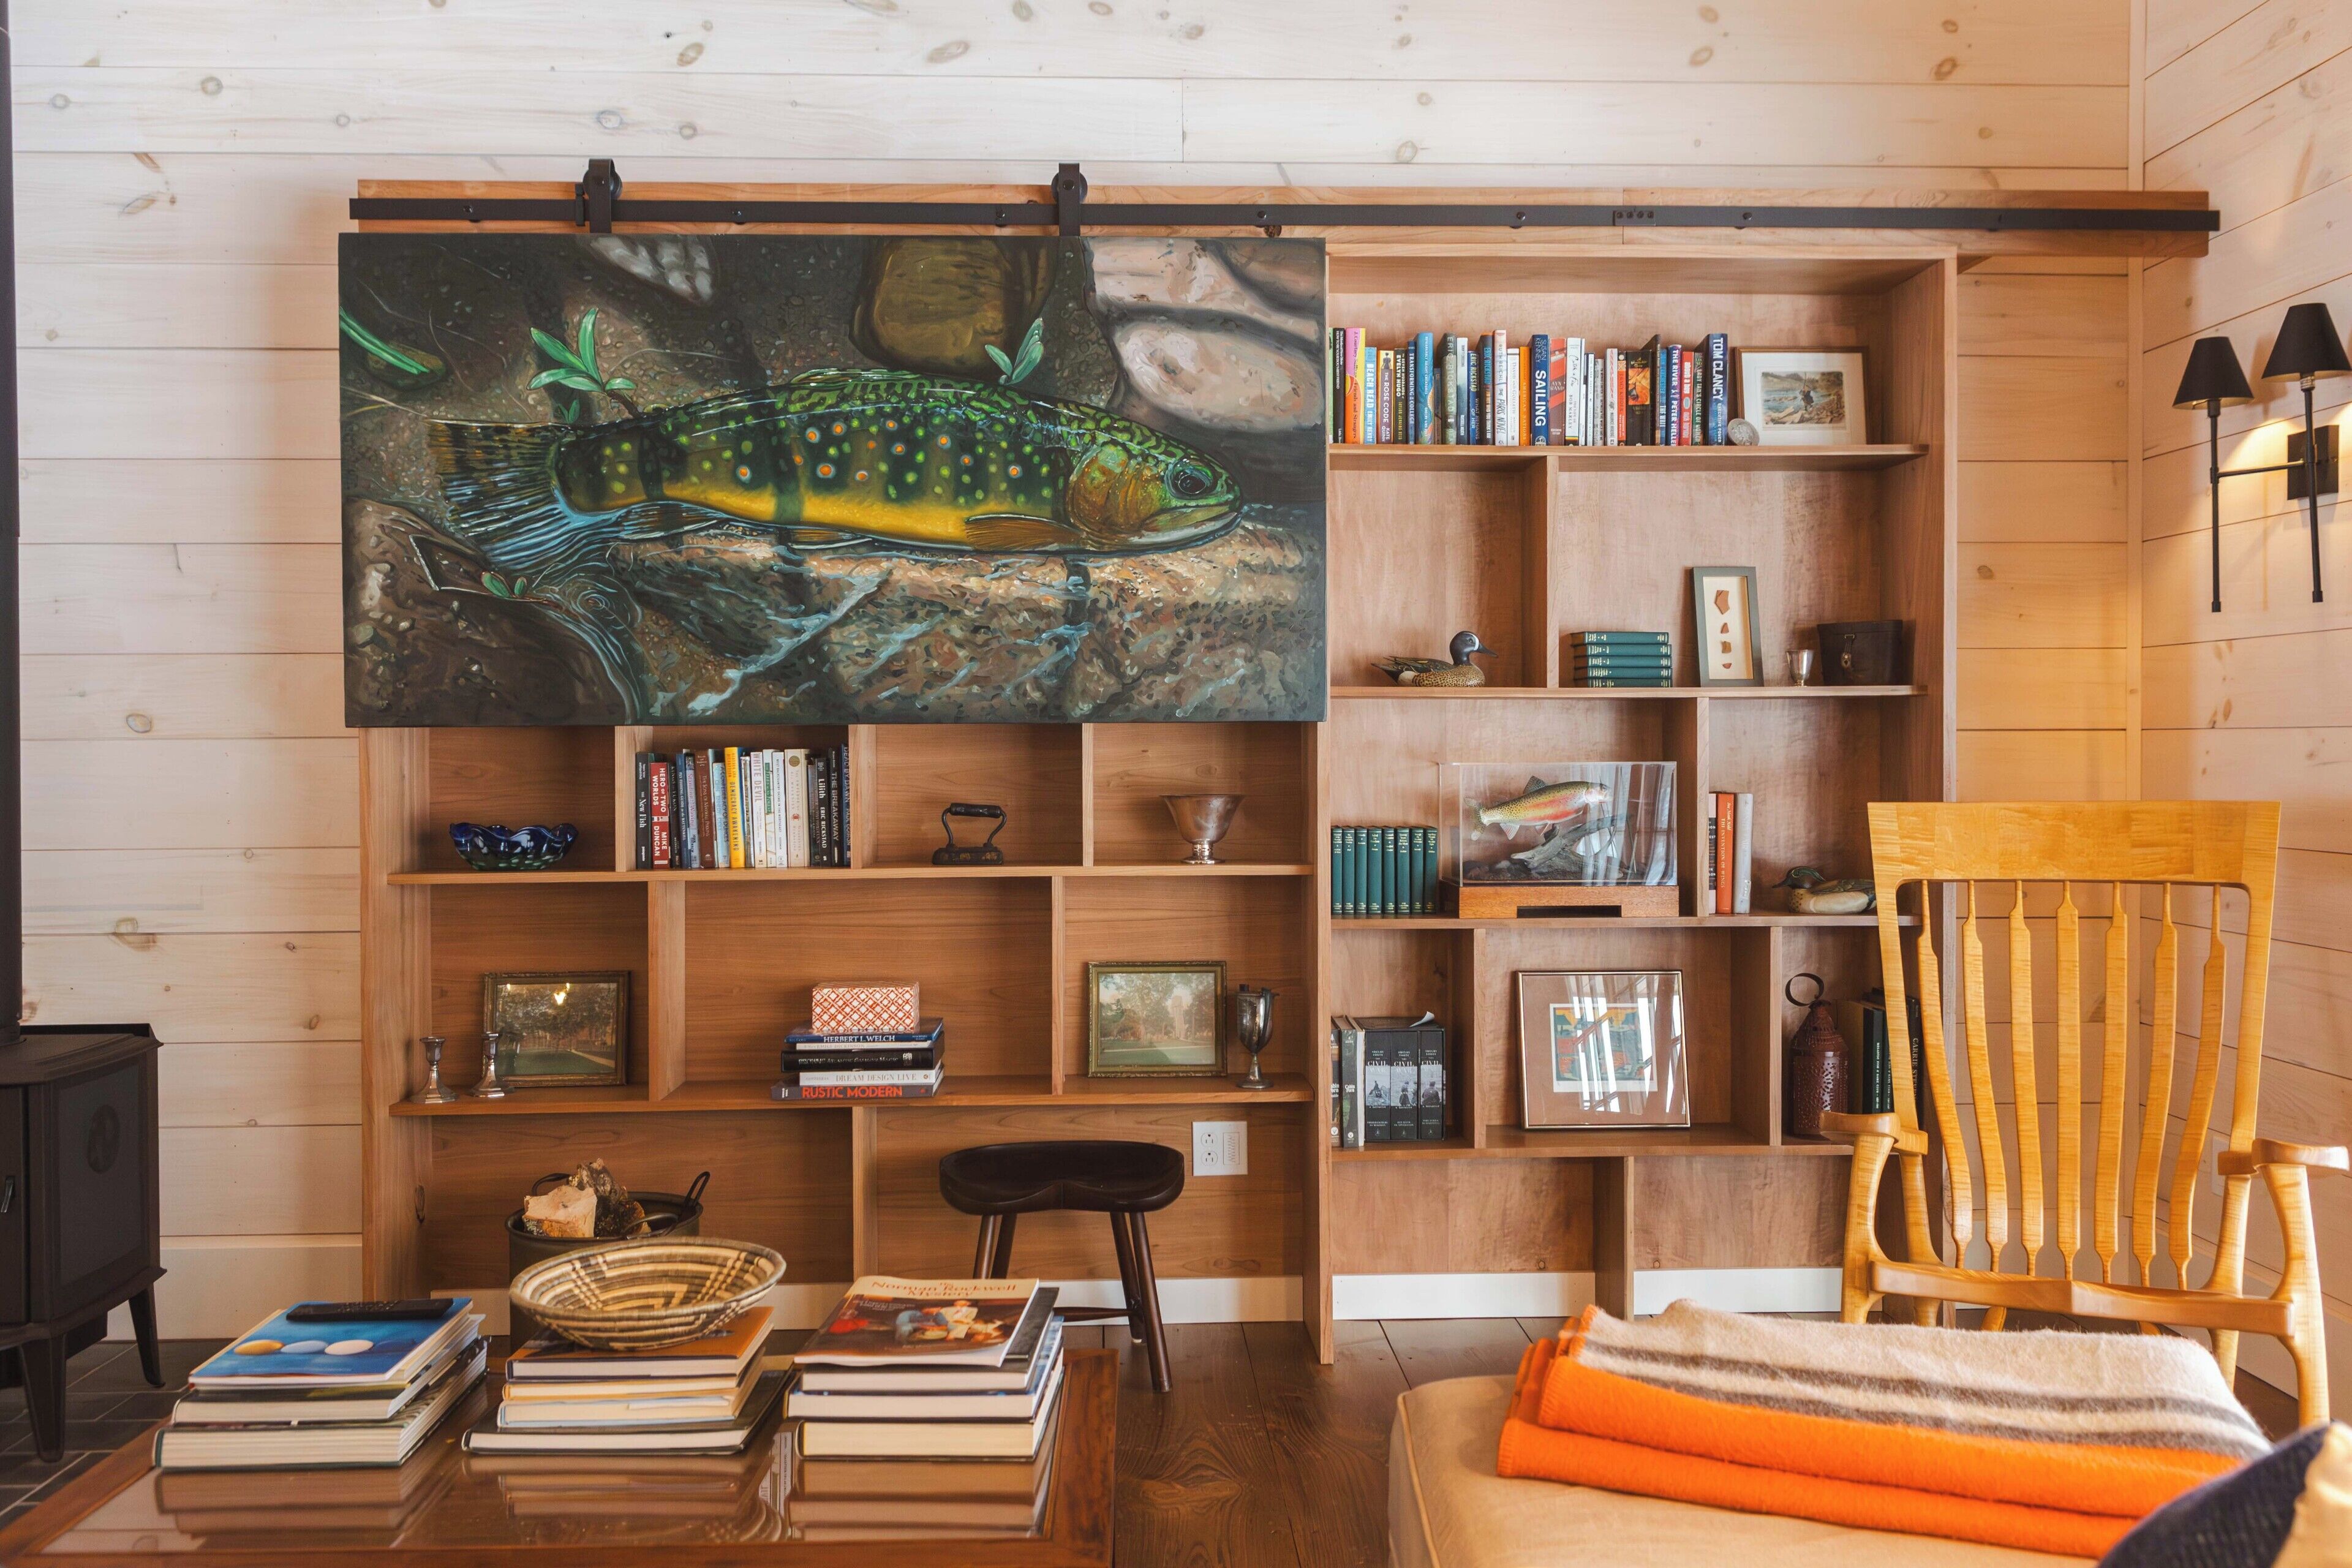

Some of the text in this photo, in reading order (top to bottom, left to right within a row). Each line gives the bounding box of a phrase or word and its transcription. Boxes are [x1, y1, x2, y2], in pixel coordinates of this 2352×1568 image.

[1713, 337, 1723, 401] TOM CLANCY
[1535, 370, 1546, 426] SAILING
[1496, 399, 1506, 415] PARIS
[1496, 417, 1506, 435] NOVEL
[753, 753, 762, 779] WHITE
[844, 768, 850, 778] BY
[802, 1086, 902, 1098] RUSTIC MODERN
[871, 1281, 1017, 1292] Norman Rockwell
